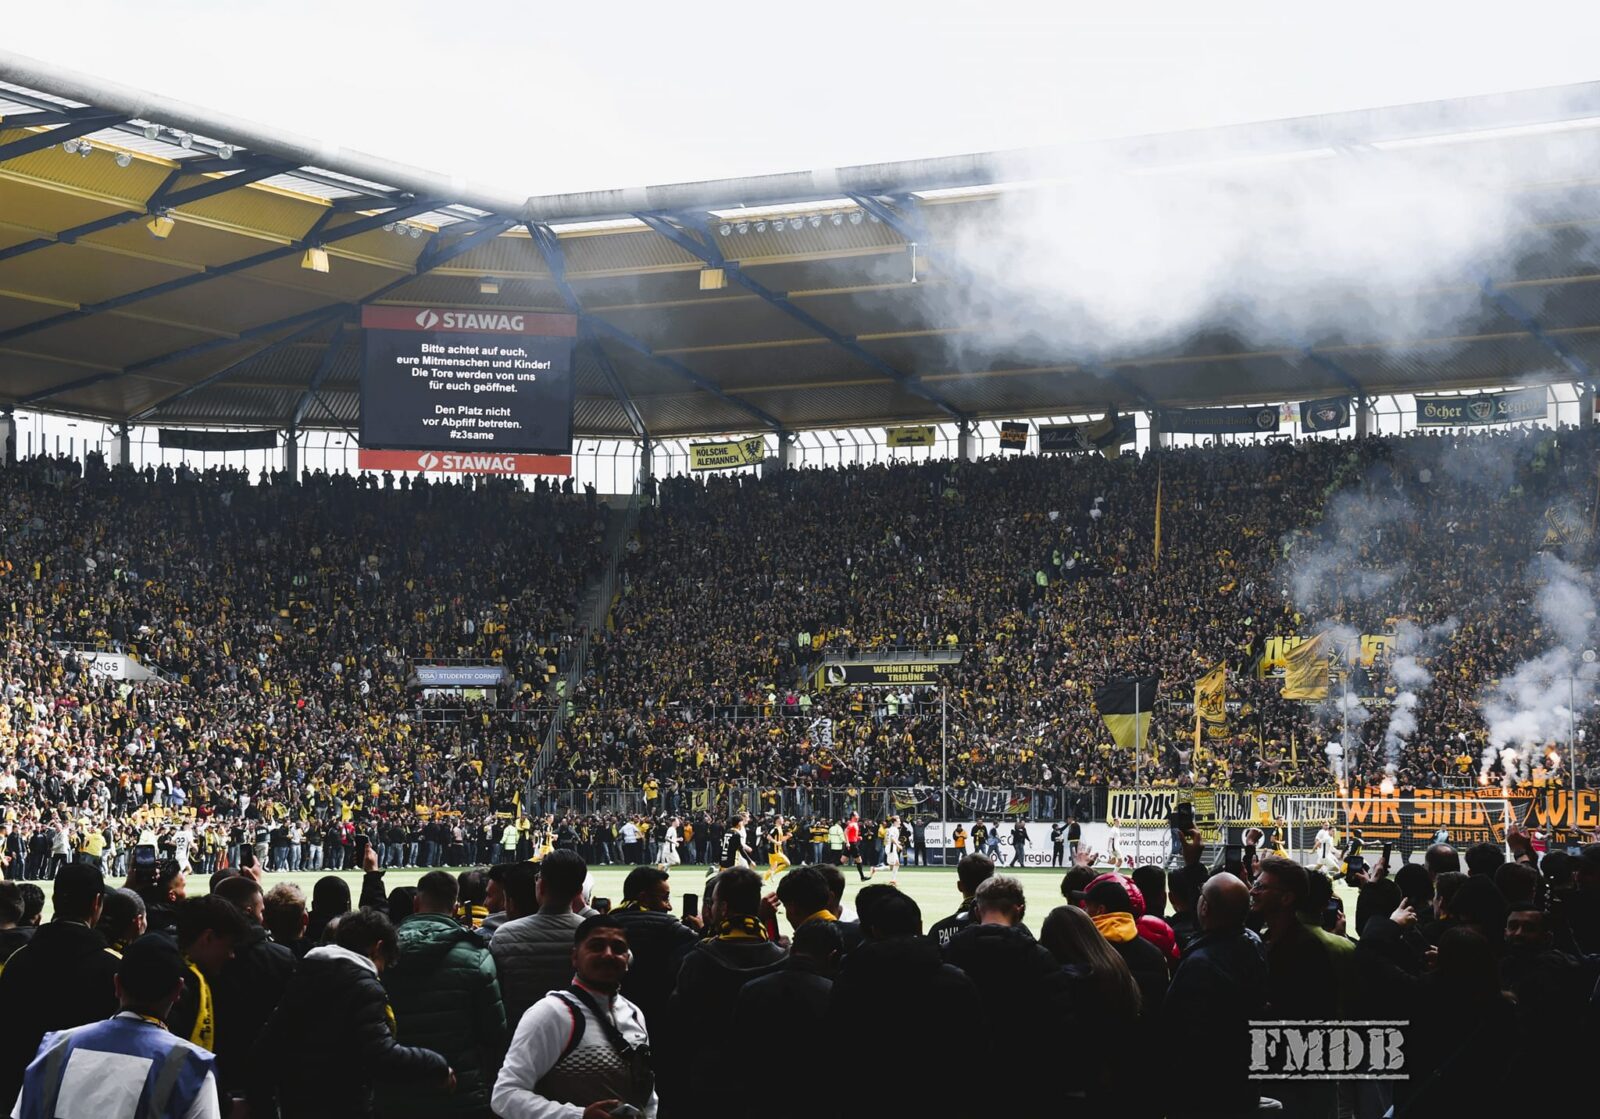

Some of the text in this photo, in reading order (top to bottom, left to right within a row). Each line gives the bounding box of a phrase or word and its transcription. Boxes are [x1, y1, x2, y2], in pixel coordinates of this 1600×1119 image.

[443, 312, 525, 331] STAWAG
[421, 344, 527, 358] Bitte achtet auf euch,
[422, 356, 489, 367] Mitmenschen
[492, 359, 512, 368] und
[514, 360, 551, 369] Kinder!
[412, 367, 536, 381] Die Tore werden von uns
[429, 380, 518, 393] für euch geöffnet.
[435, 405, 511, 416] Den Platz nicht
[1424, 400, 1541, 419] Öcher Legion
[441, 418, 476, 428] Abpfiff
[478, 419, 522, 429] betreten.
[450, 430, 494, 440] #z3same
[696, 447, 728, 456] KÖLSCHE
[442, 455, 516, 471] STAWAG
[697, 455, 739, 465] ALEMANNEN
[873, 664, 939, 673] WERNER FUCHS
[888, 673, 924, 682] TRIBÜNE
[1112, 793, 1175, 820] ULTRAS
[1449, 831, 1489, 842] SUPER
[1025, 851, 1051, 865] regio
